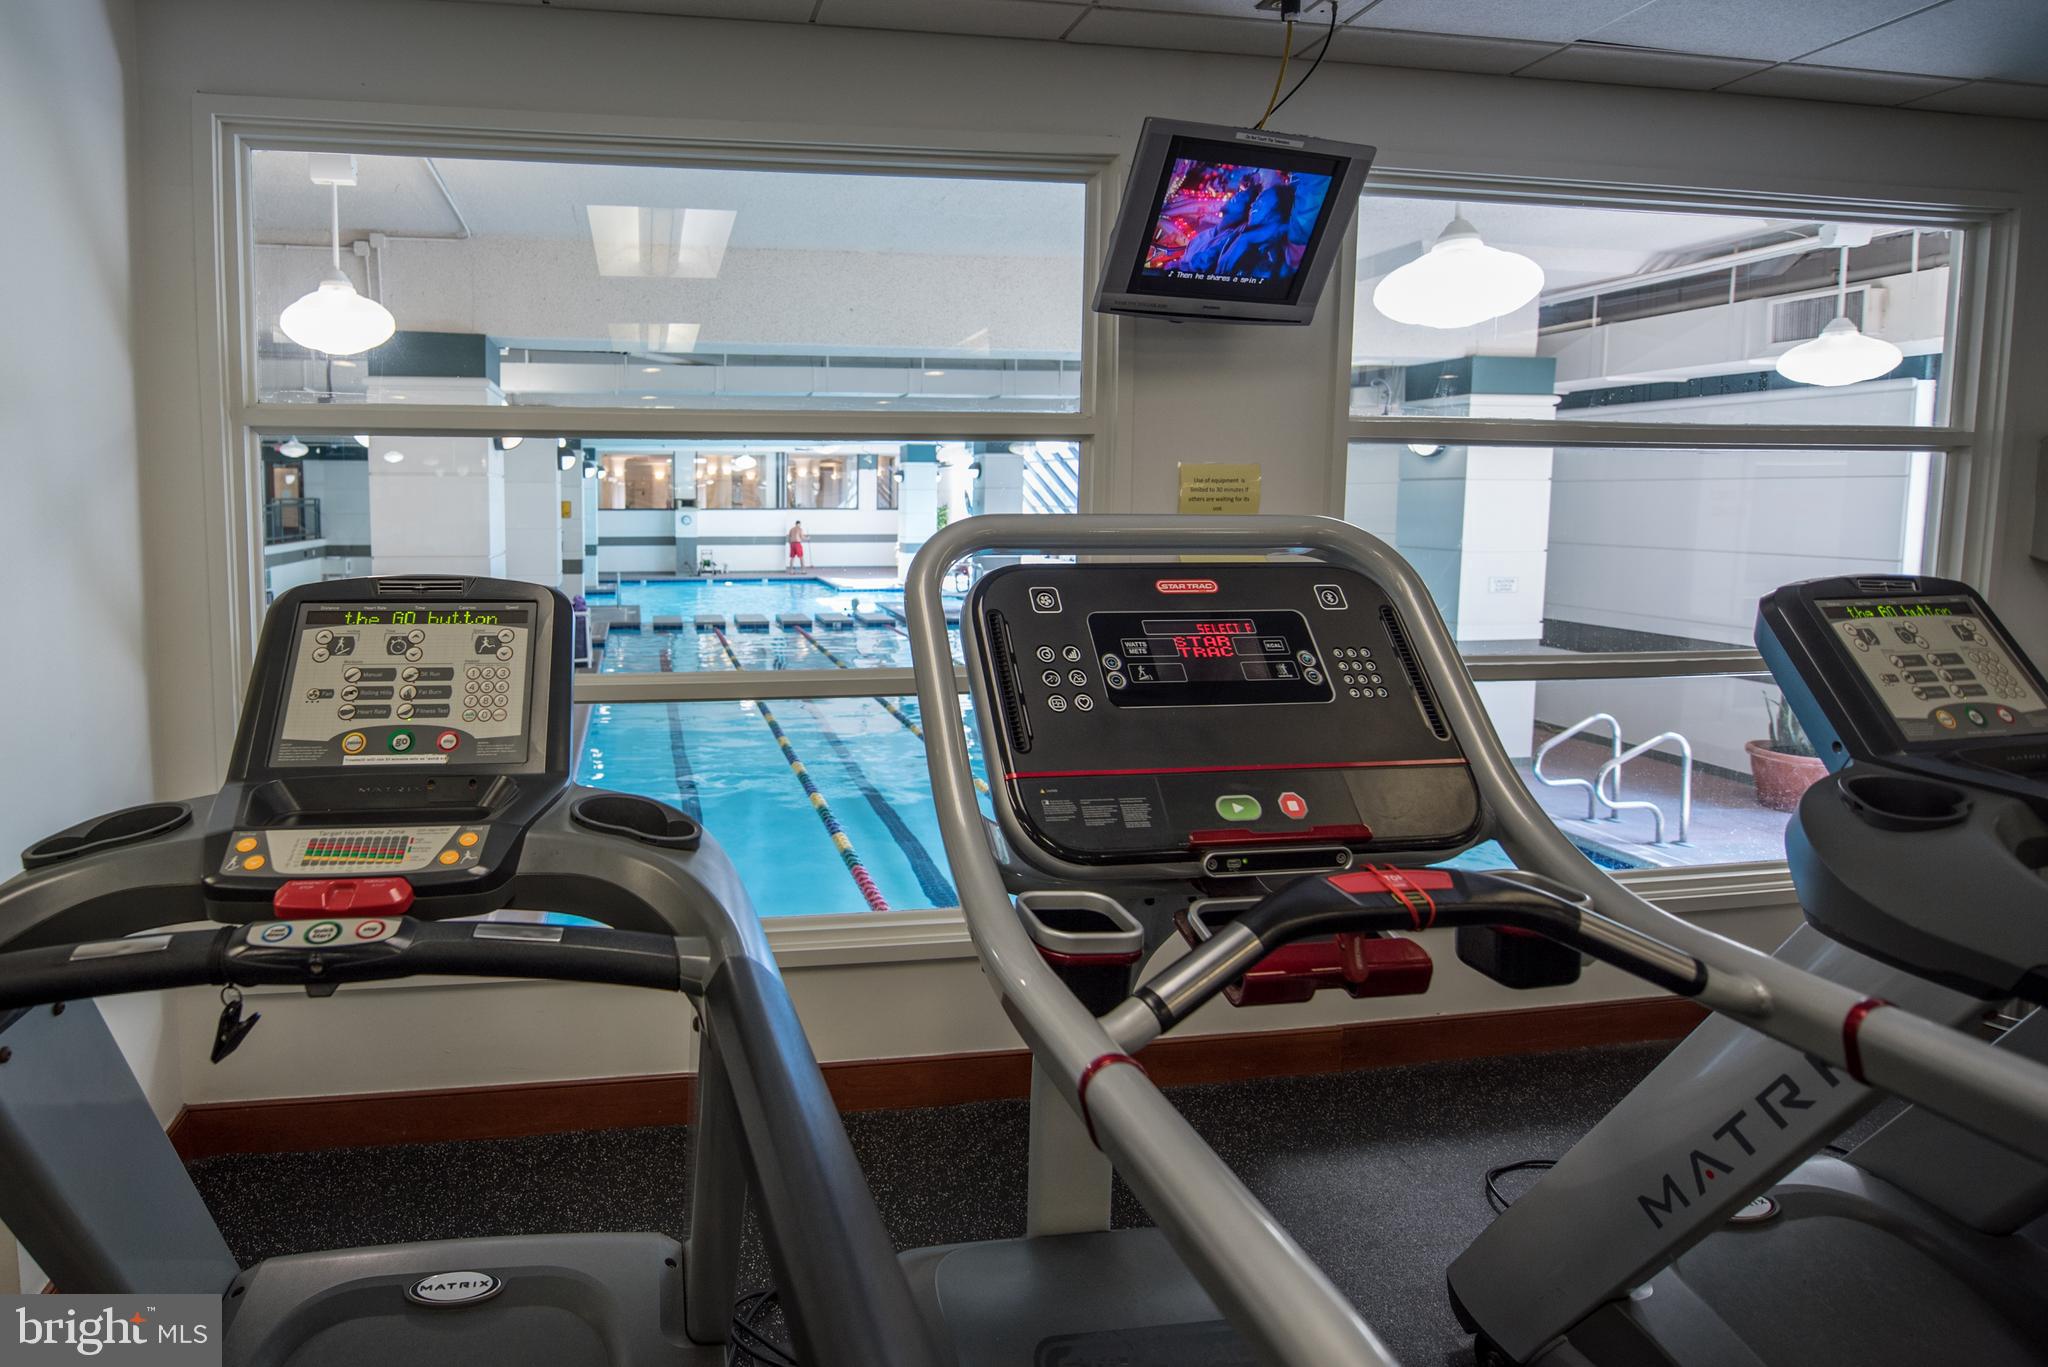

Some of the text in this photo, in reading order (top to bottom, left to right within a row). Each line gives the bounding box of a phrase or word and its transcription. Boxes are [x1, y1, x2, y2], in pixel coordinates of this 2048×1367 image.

[1177, 271, 1193, 279] Then
[1195, 272, 1205, 280] he
[1207, 274, 1231, 282] shares
[345, 611, 380, 625] the
[428, 611, 498, 625] button
[1846, 605, 1875, 620] the
[1900, 604, 1952, 618] button
[1196, 623, 1240, 635] SELECT
[1174, 635, 1231, 648] STAR
[1179, 646, 1234, 659] TRAC
[394, 738, 408, 748] go
[1637, 1053, 1840, 1229] MATRI
[420, 1280, 489, 1292] MATRIX
